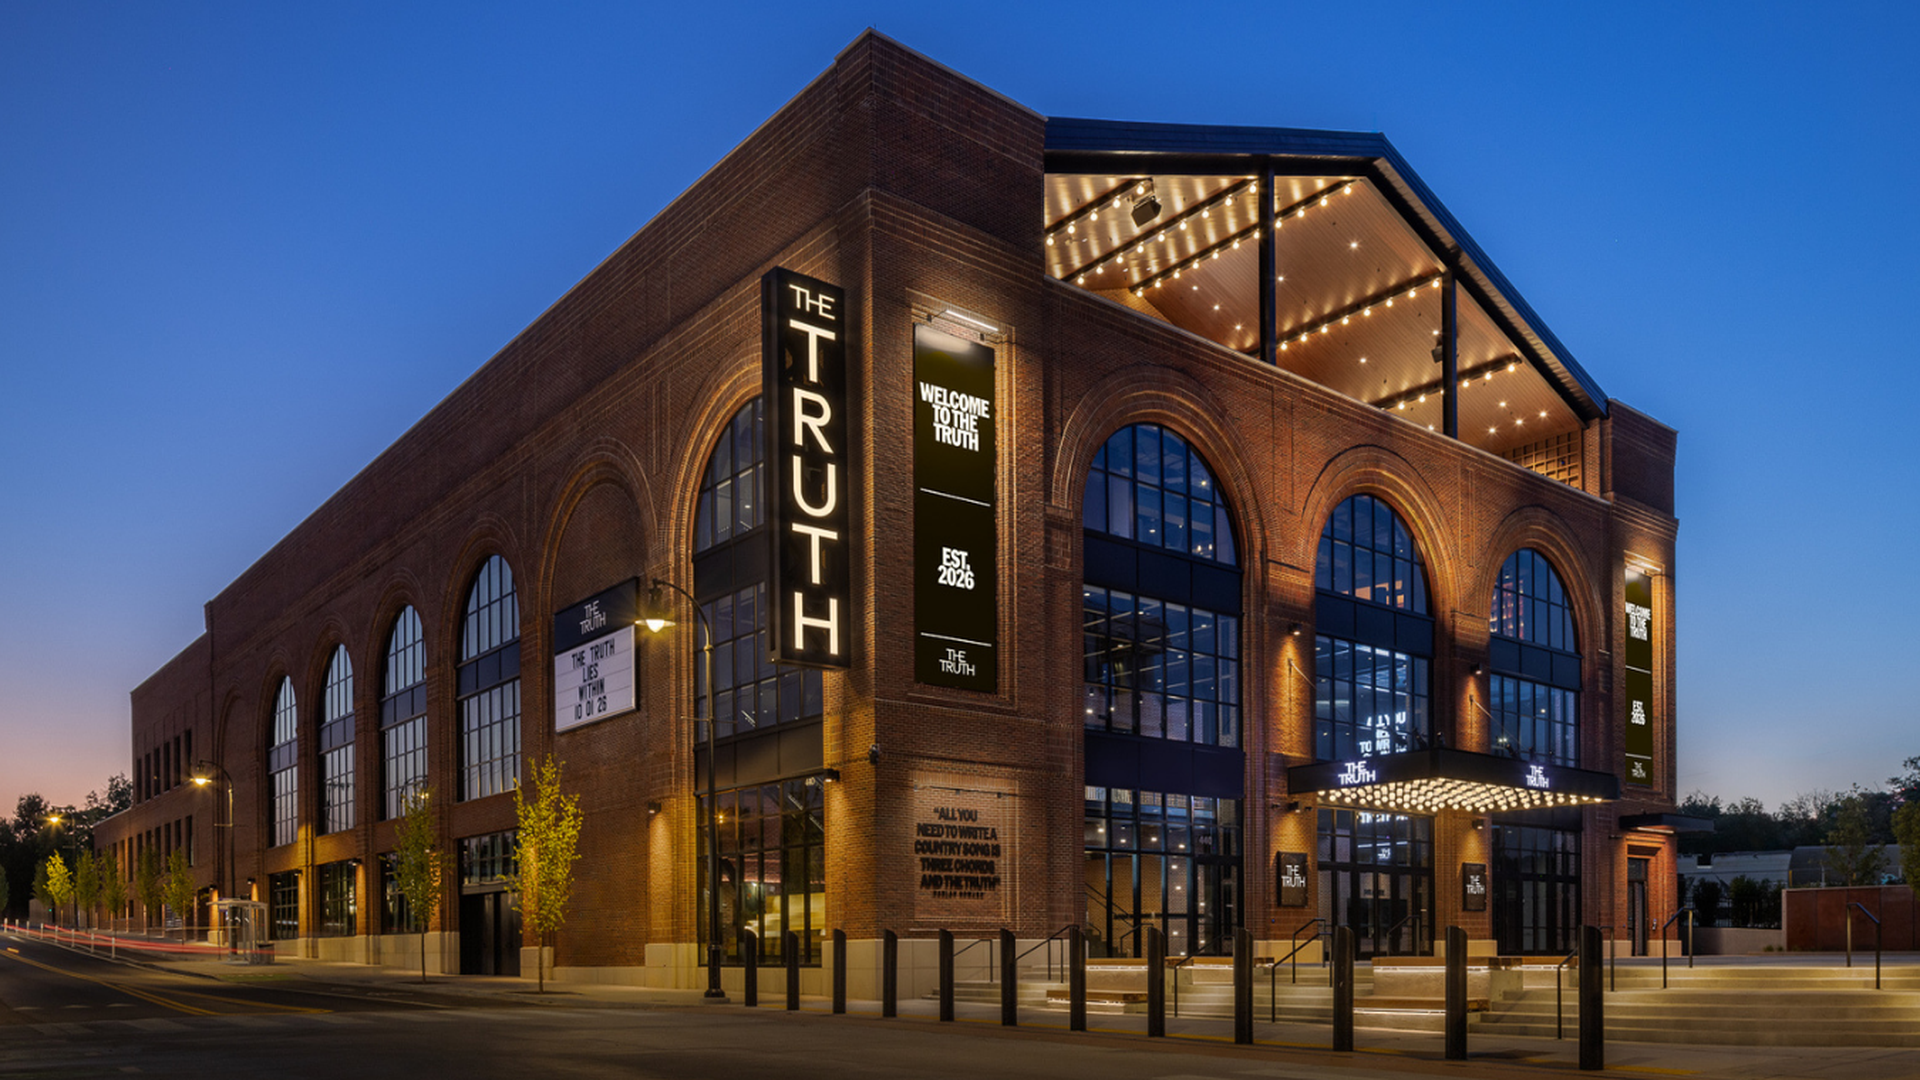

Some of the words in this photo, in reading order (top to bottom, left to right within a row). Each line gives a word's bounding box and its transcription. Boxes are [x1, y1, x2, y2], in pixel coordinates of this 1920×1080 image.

[789, 284, 836, 320] THE
[919, 381, 990, 419] WELCOME
[932, 403, 951, 425] TO
[951, 408, 979, 433] THE
[933, 421, 979, 452] TRUTH
[789, 319, 838, 656] TRUTH
[942, 546, 971, 570] EST.
[937, 565, 975, 590] 2026
[584, 600, 600, 617] THE
[579, 612, 607, 635] TRUTH
[571, 649, 586, 670] THE
[590, 638, 615, 662] TRUTH
[946, 648, 967, 663] THE
[582, 663, 599, 683] LIES
[939, 659, 976, 677] TRUTH
[578, 678, 605, 701] WITHIN
[1345, 760, 1367, 774] THE
[1529, 764, 1544, 777] THE
[1338, 769, 1377, 785] TRUTH
[1525, 774, 1550, 788] TRUTH
[957, 808, 978, 822] YOU
[916, 823, 944, 837] NEED
[944, 825, 958, 838] TO
[958, 825, 989, 839] WRITE
[989, 828, 998, 840] A
[914, 840, 962, 856] COUNTRY
[962, 842, 990, 857] SONG
[920, 857, 954, 872] THREE
[1286, 864, 1299, 876] THE
[920, 874, 943, 890] AND
[1281, 875, 1306, 888] TRUTH
